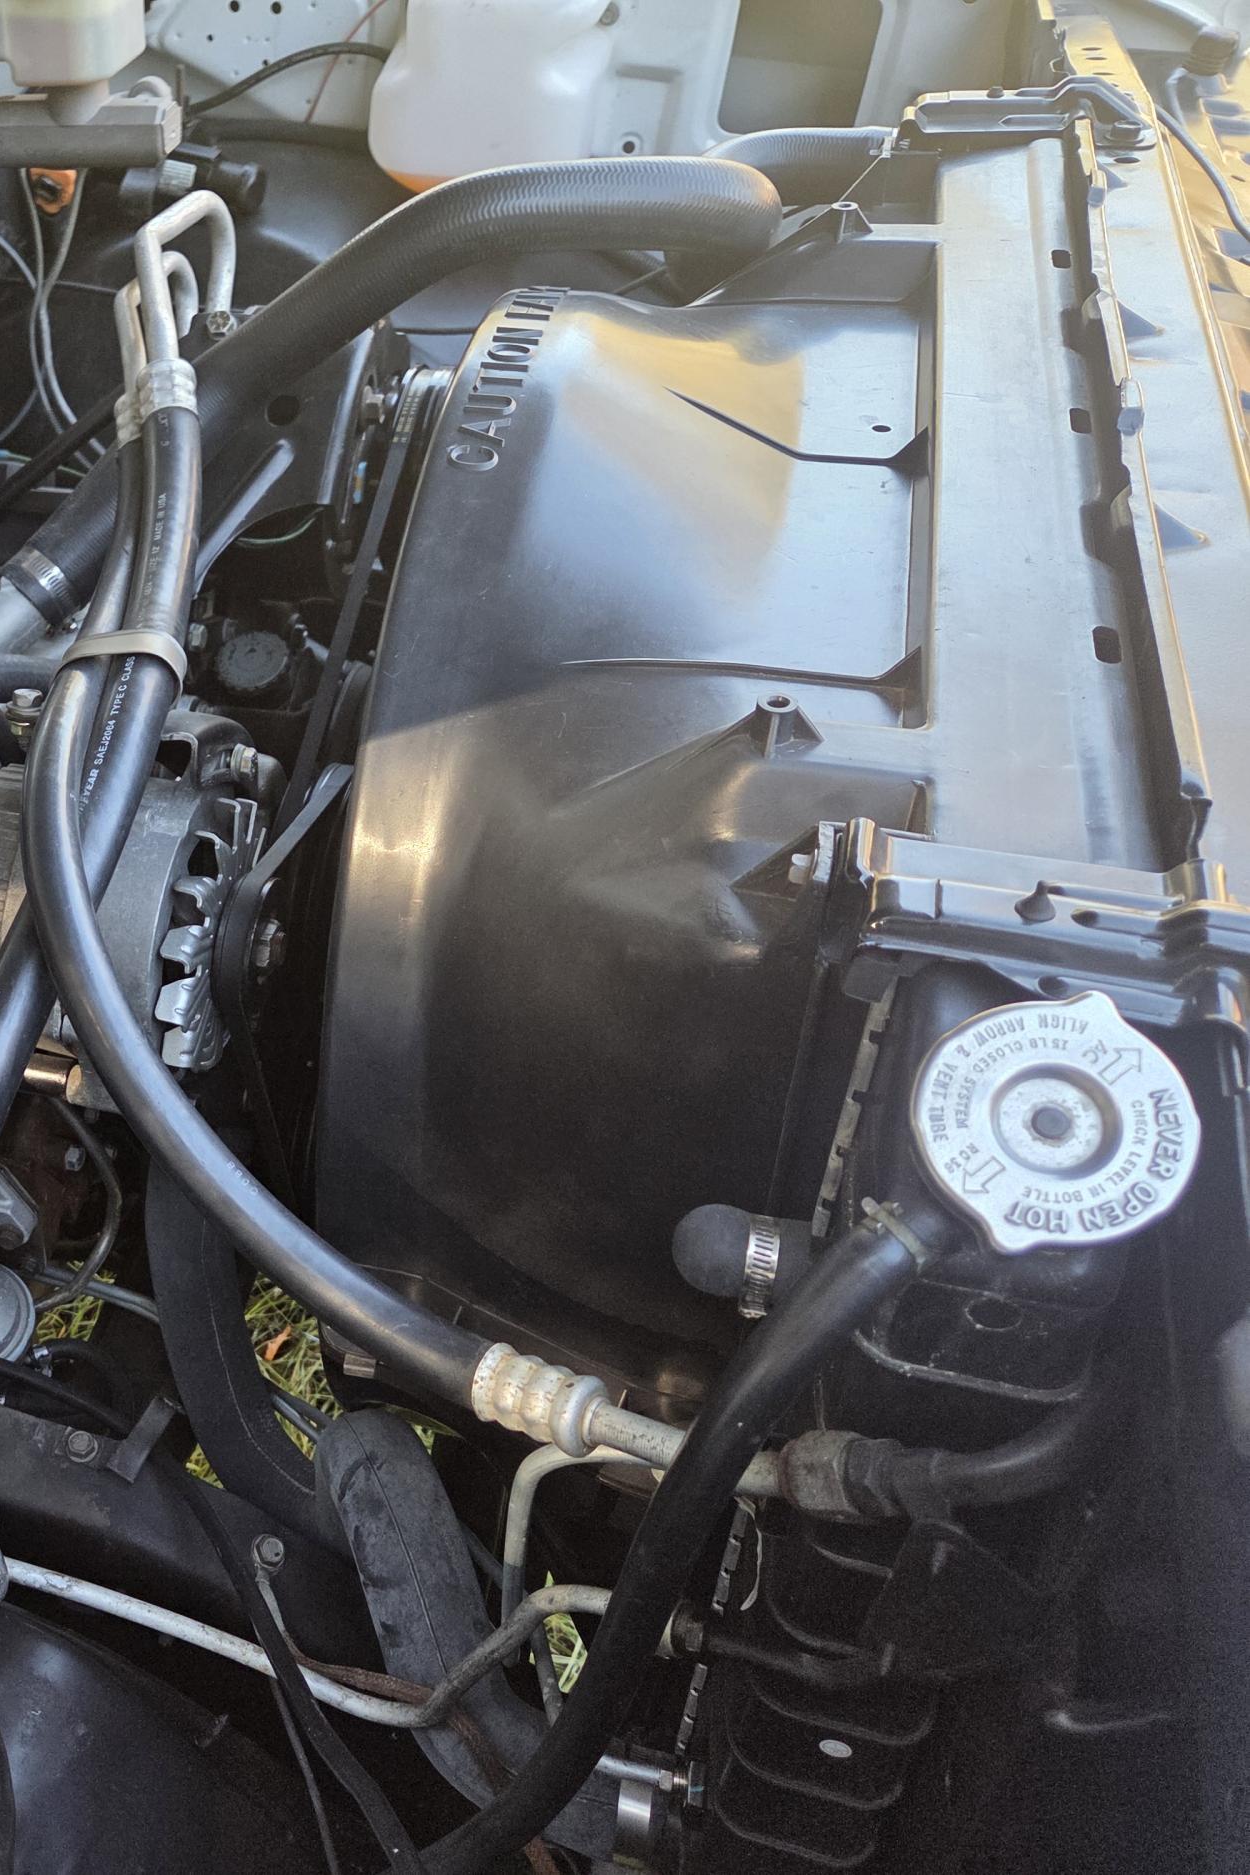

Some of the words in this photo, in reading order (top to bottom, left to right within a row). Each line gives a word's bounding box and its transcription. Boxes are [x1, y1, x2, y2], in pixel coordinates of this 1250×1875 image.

[446, 326, 545, 471] CAUTION
[110, 692, 125, 717] TYPE
[121, 655, 136, 682] CLASS
[972, 1016, 1026, 1047] ARROW
[1037, 1013, 1089, 1035] ALIGN
[955, 1043, 972, 1058] &
[972, 1040, 1023, 1073] CLOSED
[1052, 1038, 1069, 1050] 15
[1081, 1039, 1109, 1065] AC
[931, 1062, 959, 1100] VENT
[955, 1076, 977, 1129] SYSTEM
[928, 1106, 949, 1143] TUBE
[1131, 1099, 1148, 1146] CHECK
[1147, 1088, 1183, 1181] NEVER
[1105, 1151, 1143, 1187] LEVEL
[1021, 1185, 1084, 1203] BOTTLE
[1078, 1181, 1158, 1233] OPEN
[1087, 1183, 1106, 1198] IN
[1004, 1200, 1069, 1234] HOT
